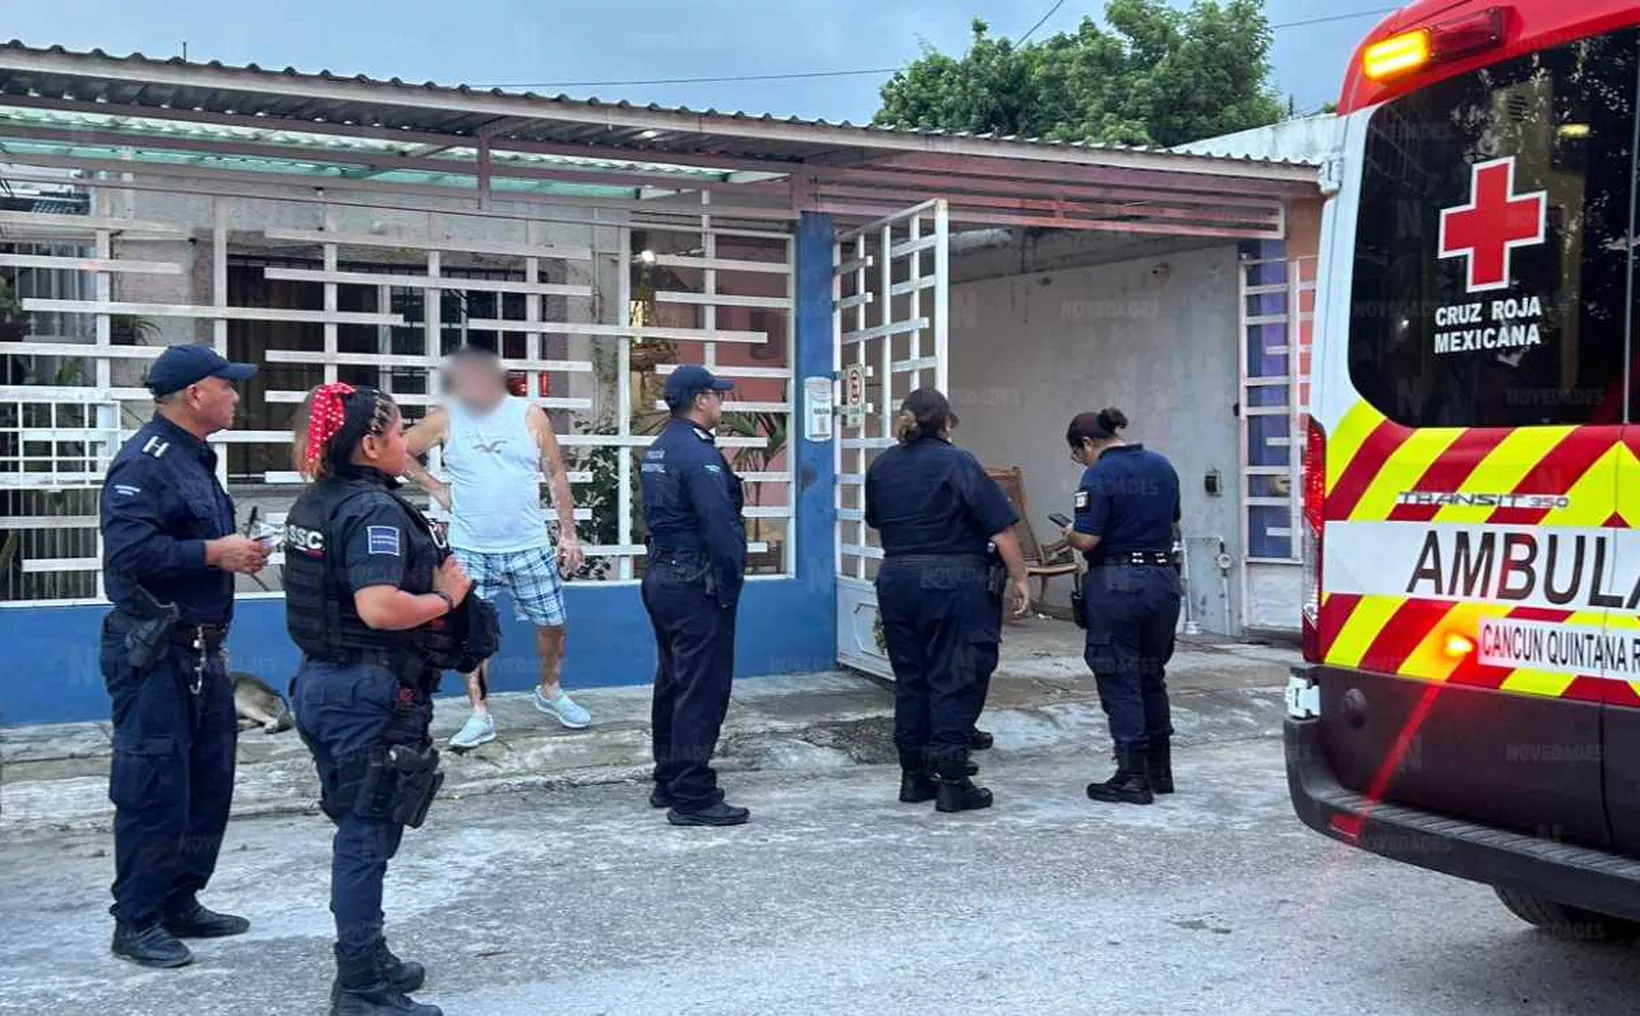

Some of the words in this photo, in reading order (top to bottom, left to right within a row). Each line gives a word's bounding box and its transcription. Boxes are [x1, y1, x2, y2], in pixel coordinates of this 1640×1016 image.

[1435, 303, 1482, 326] CRUZ
[1492, 296, 1542, 320] ROJA
[1434, 324, 1542, 354] MEXICANA
[1400, 491, 1524, 509] TRANSIT
[1530, 496, 1570, 509] 350
[1483, 624, 1544, 662] CANCUN
[1547, 631, 1630, 672] QUINTANA
